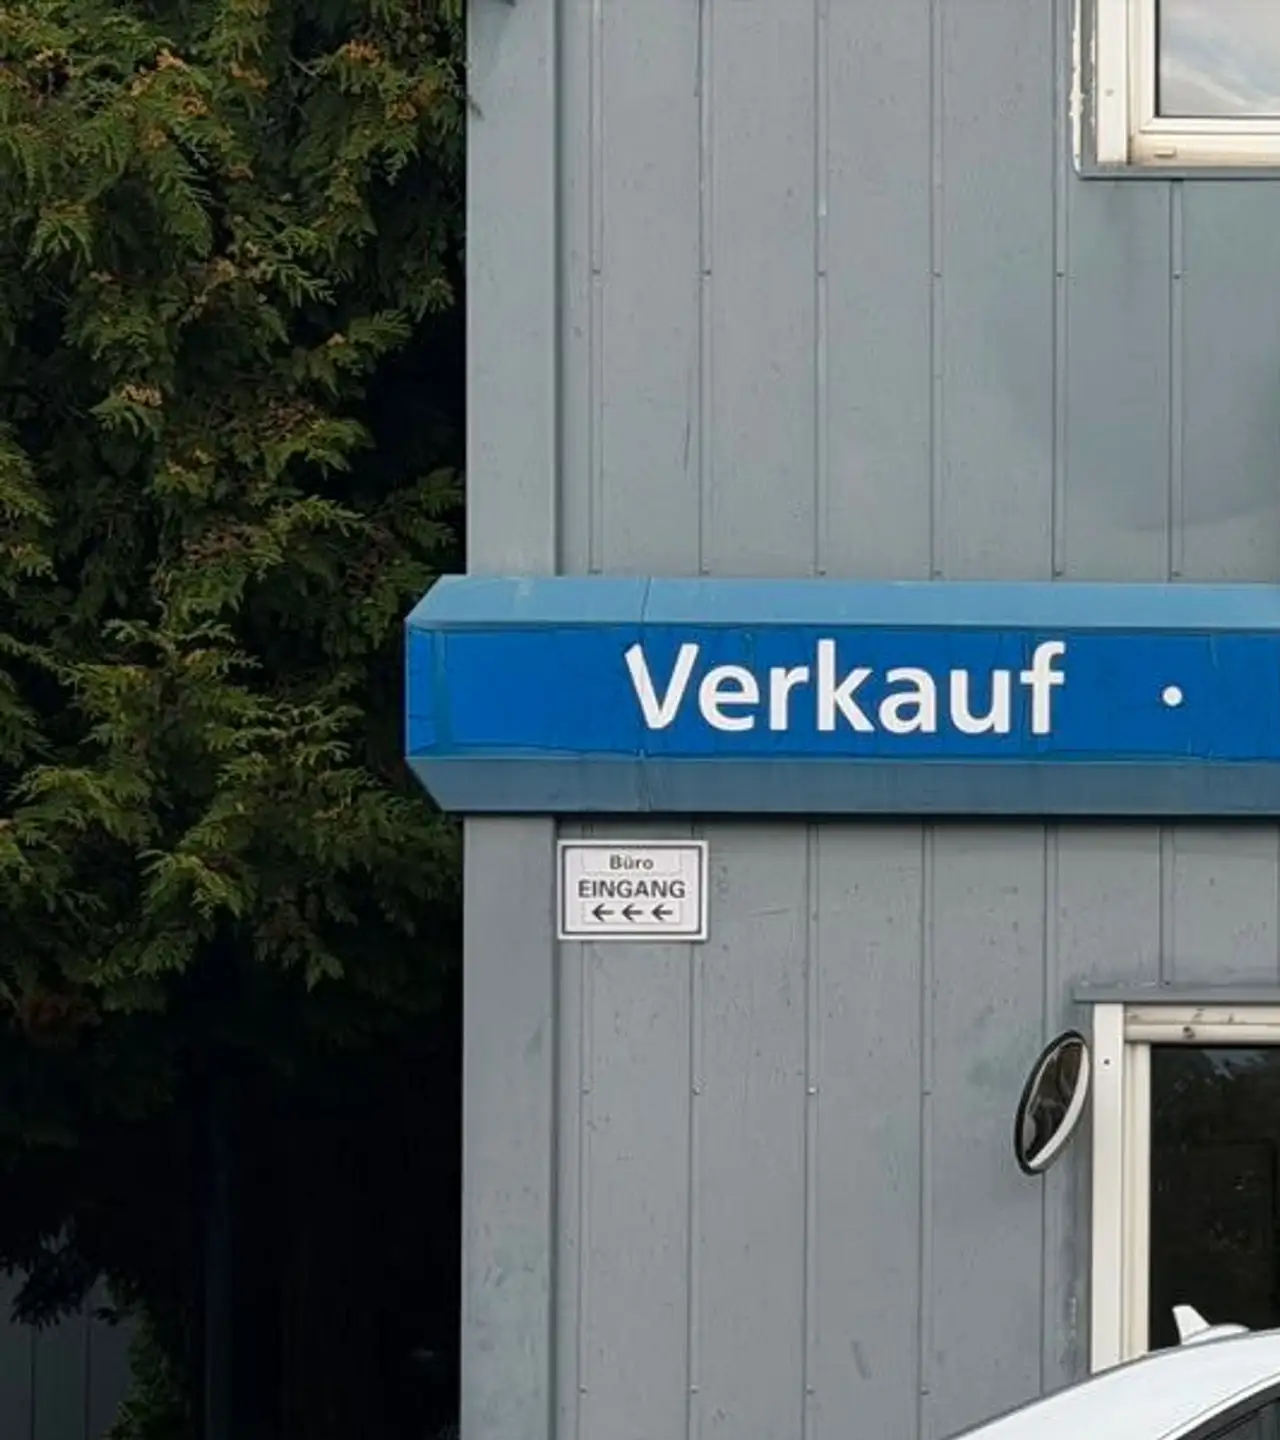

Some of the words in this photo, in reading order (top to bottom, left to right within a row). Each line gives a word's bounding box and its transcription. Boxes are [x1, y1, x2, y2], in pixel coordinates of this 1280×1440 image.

[624, 638, 1067, 735] Verkauf
[609, 854, 655, 870] Büro
[577, 879, 687, 898] EINGANG
